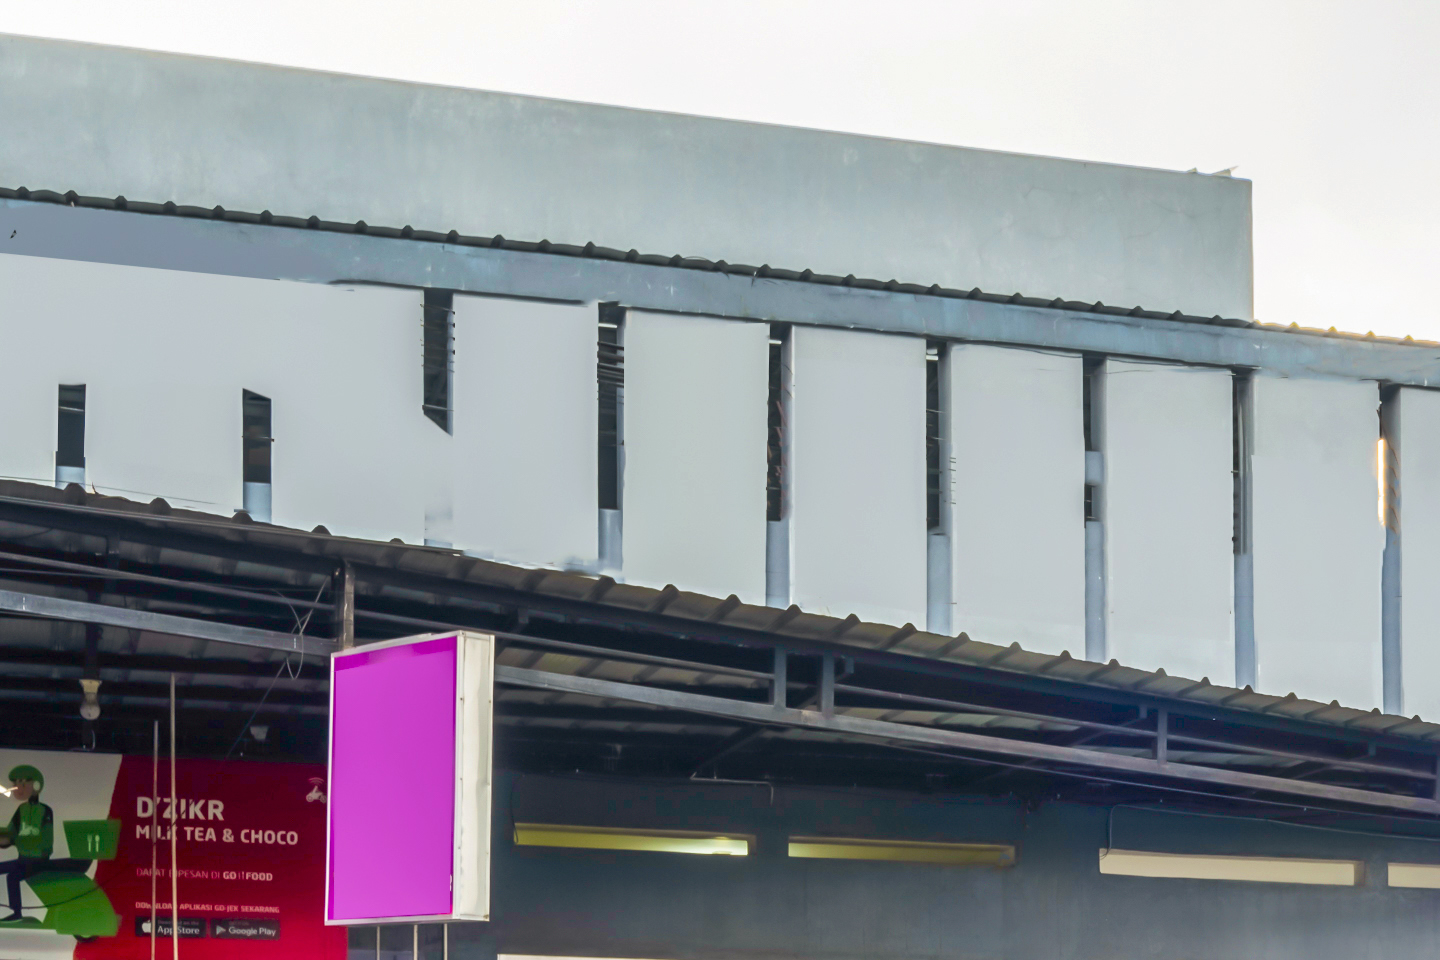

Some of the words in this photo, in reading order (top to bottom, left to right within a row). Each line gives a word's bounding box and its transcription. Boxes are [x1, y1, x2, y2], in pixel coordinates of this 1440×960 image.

[137, 796, 224, 820] D'ZIKR
[136, 825, 178, 840] MLK
[184, 826, 216, 842] TEA
[222, 828, 234, 843] &
[240, 828, 298, 845] CHOCO
[223, 871, 237, 880] GO
[246, 872, 274, 882] FOOD
[179, 902, 213, 912] APLIKASI
[240, 905, 281, 914] SEKARANG
[177, 926, 201, 935] Store
[228, 926, 258, 937] Google
[259, 927, 277, 937] Play
